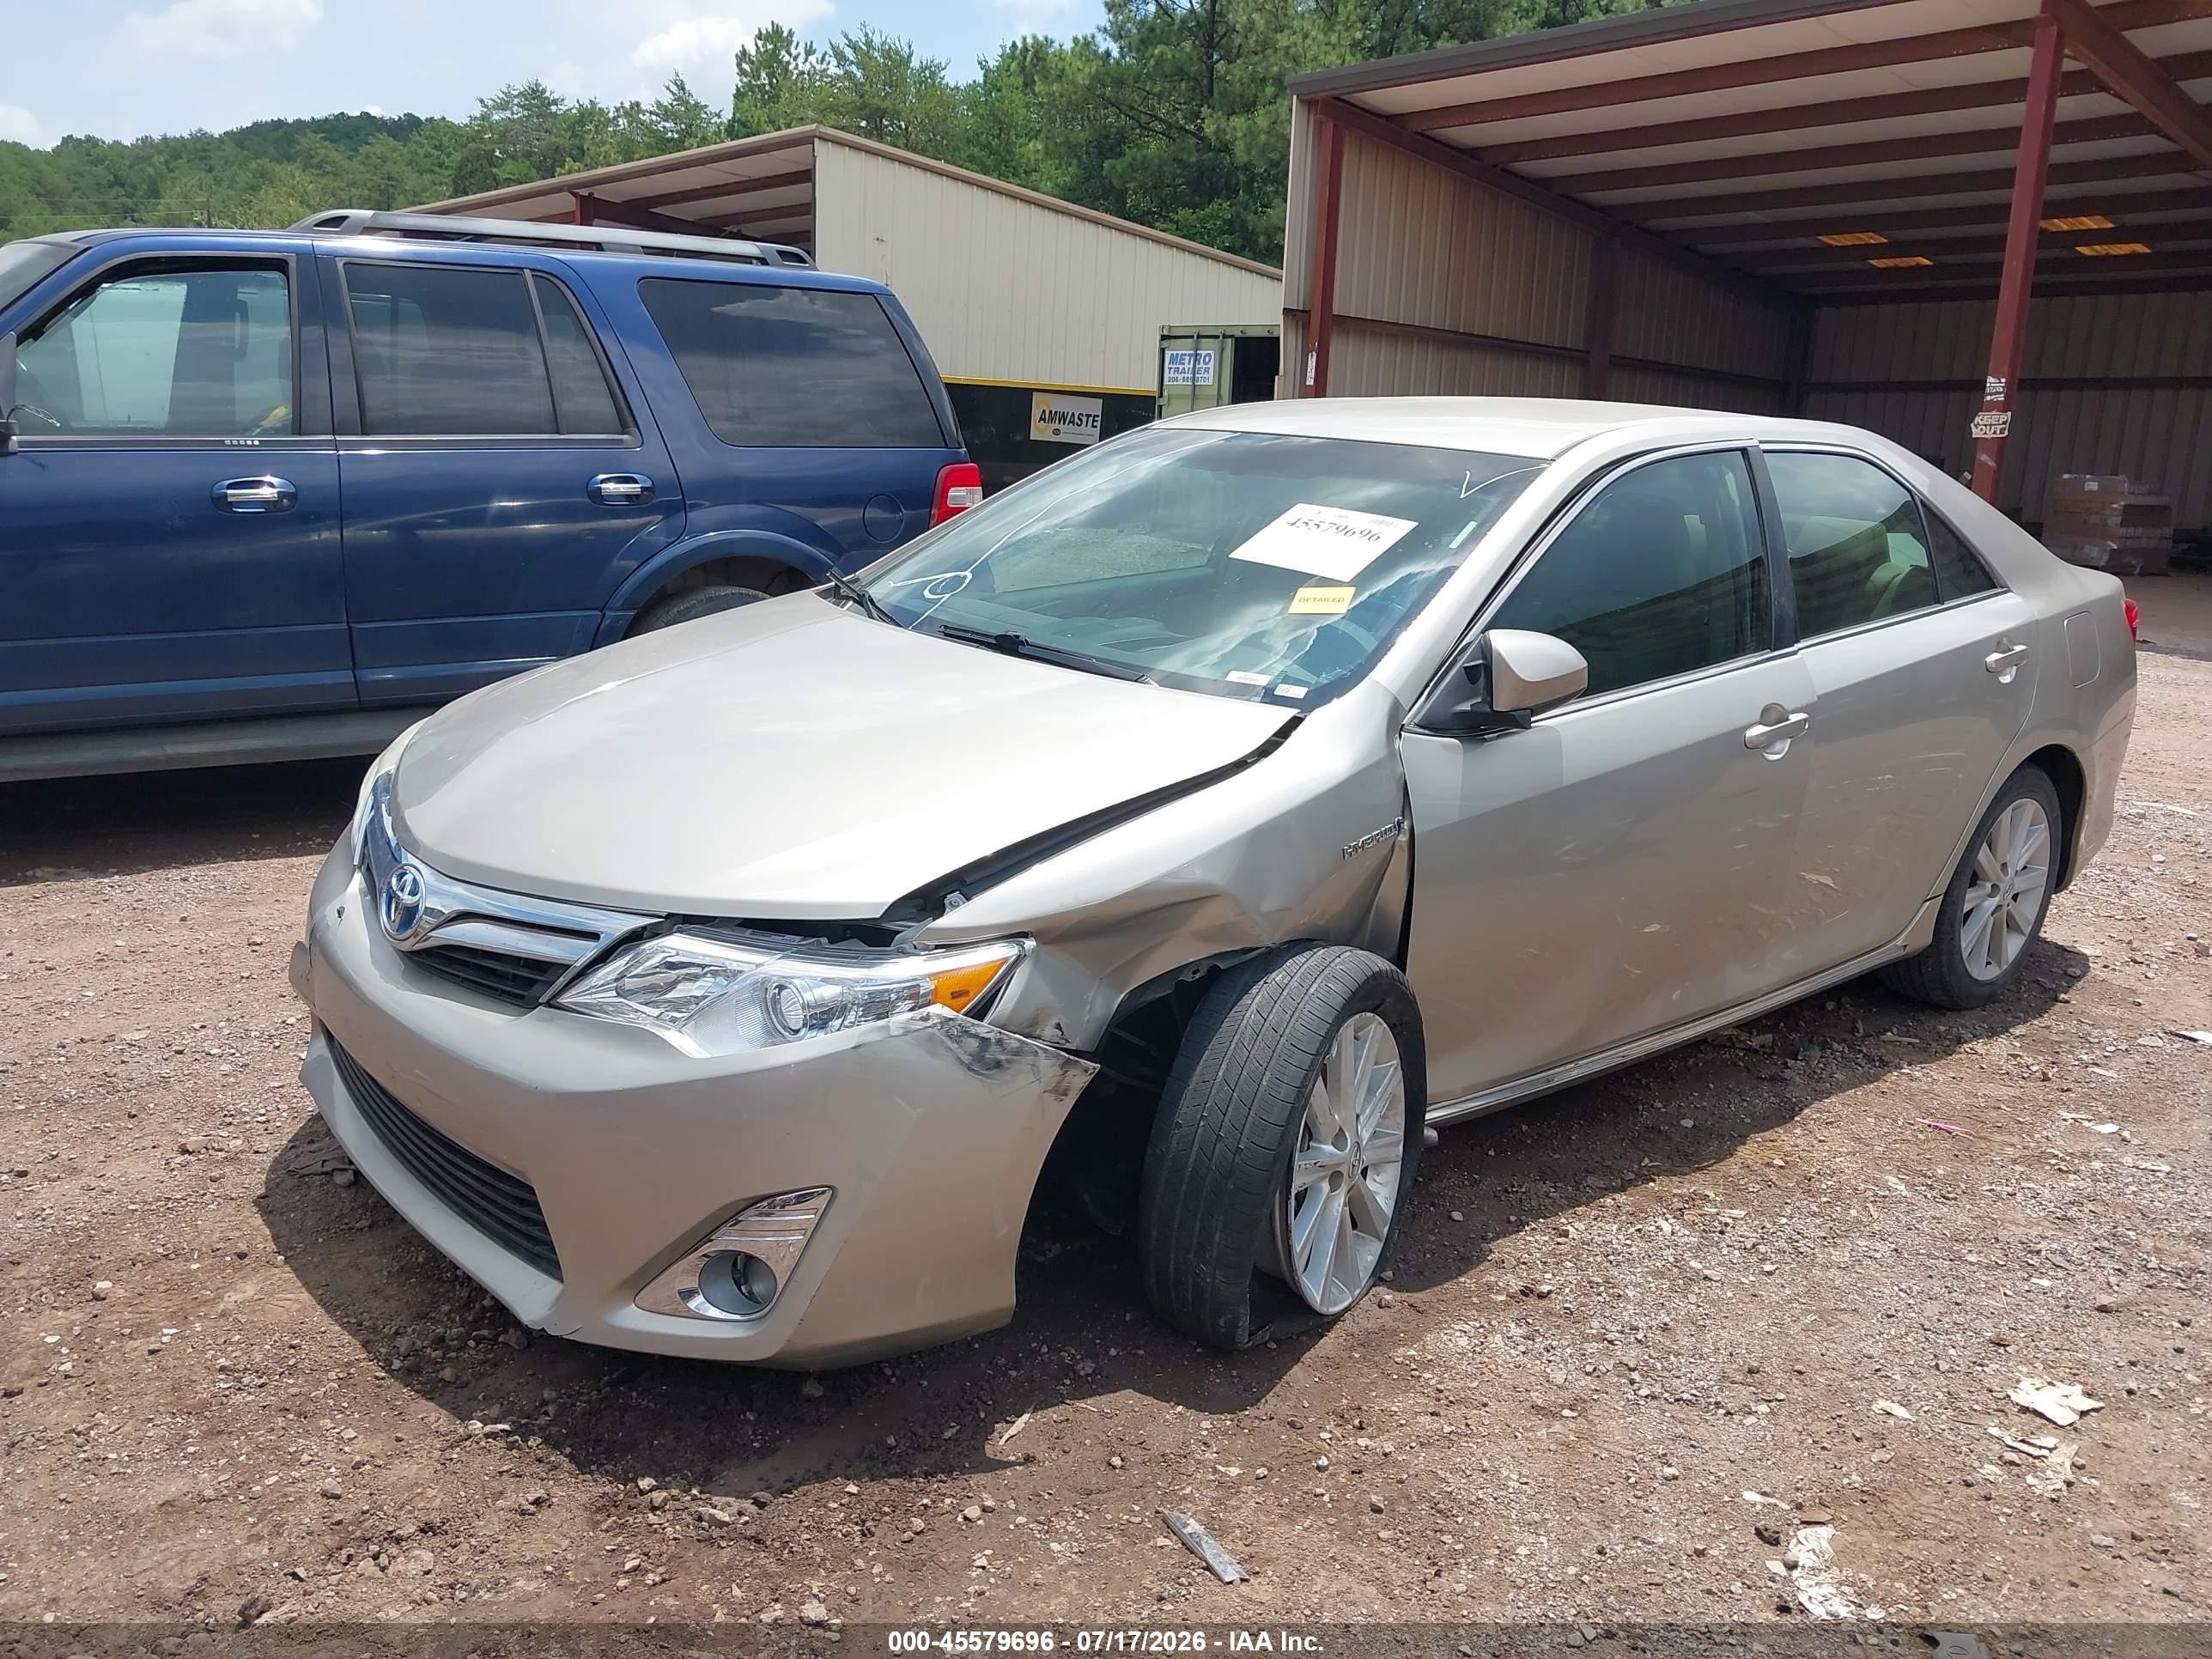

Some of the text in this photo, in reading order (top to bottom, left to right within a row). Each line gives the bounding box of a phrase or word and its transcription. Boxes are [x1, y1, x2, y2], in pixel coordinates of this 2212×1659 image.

[1168, 352, 1212, 366] METRO
[1037, 409, 1100, 429] AMWASTE
[1978, 415, 2008, 425] KEEP
[1978, 425, 2007, 434] OUT
[1286, 517, 1382, 543] 45579696
[1342, 822, 1398, 860] HYBRID
